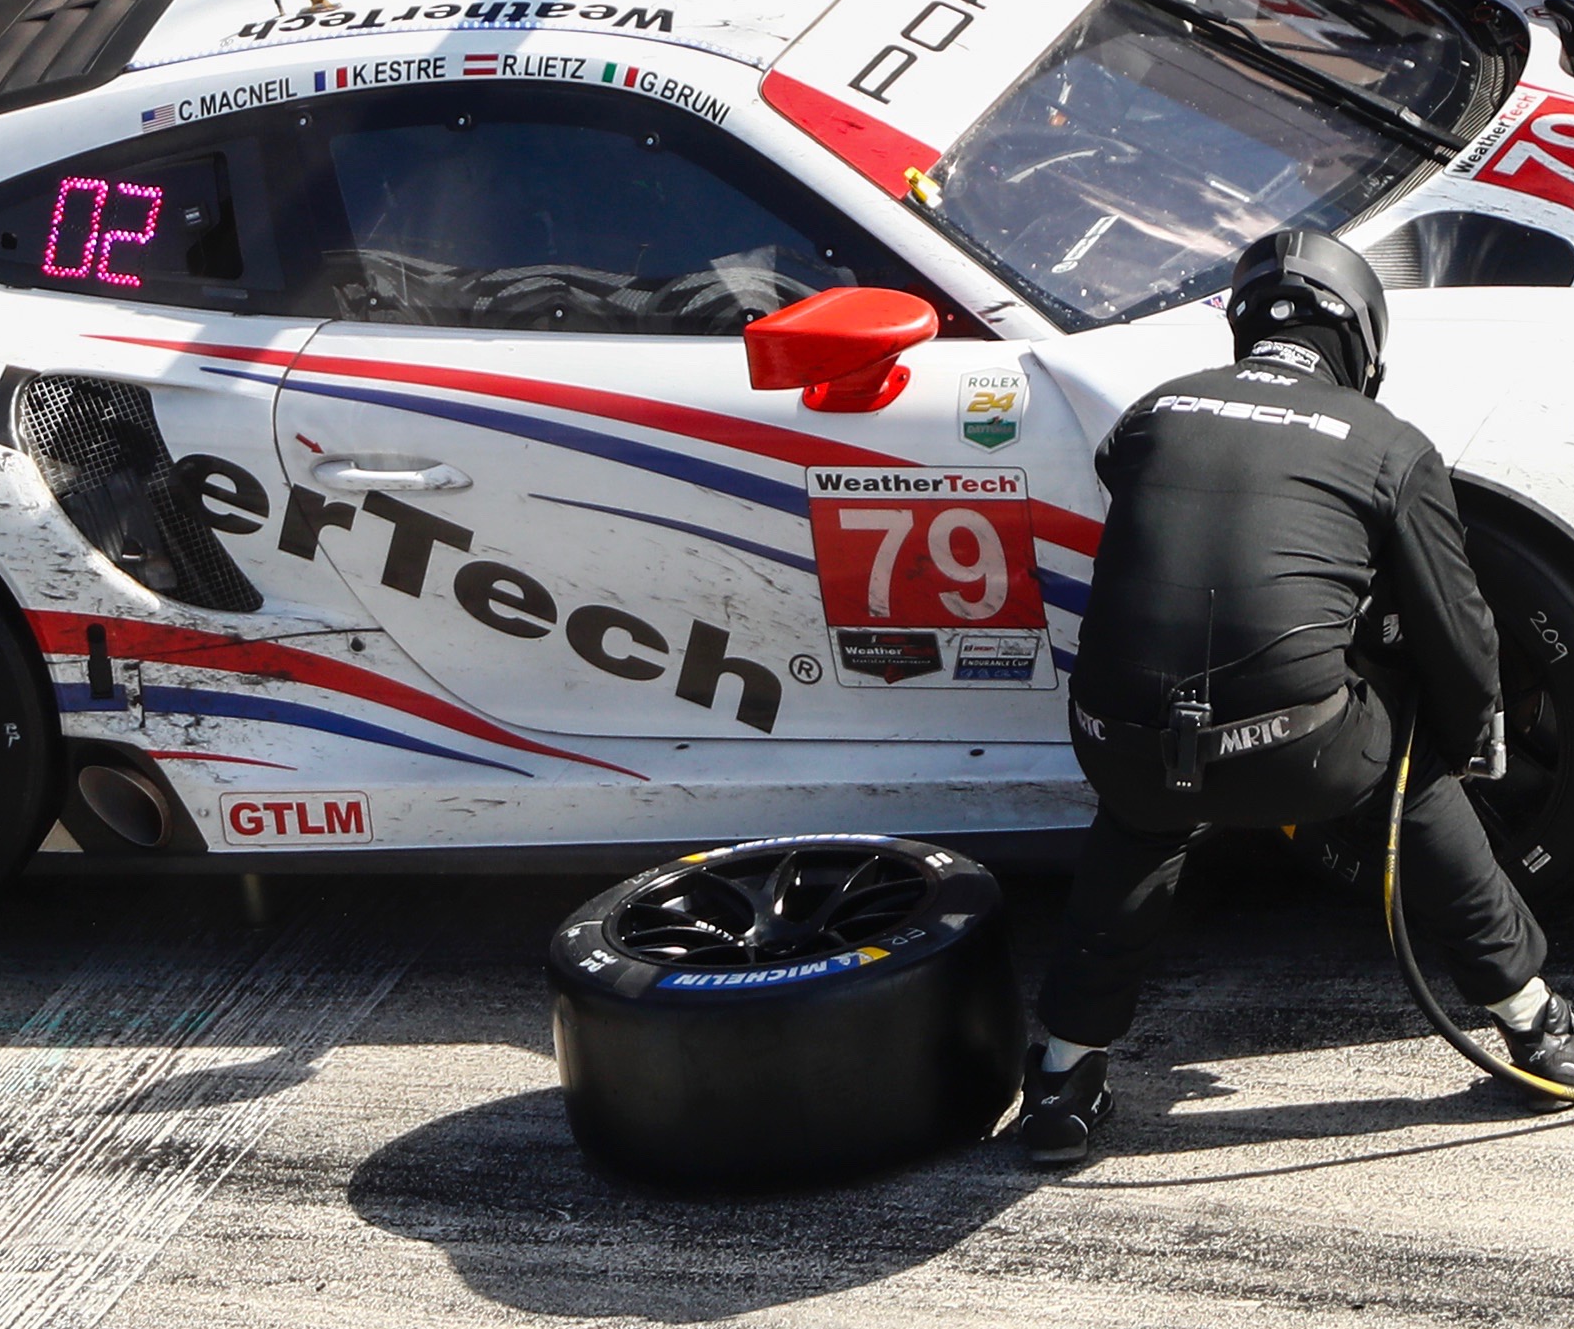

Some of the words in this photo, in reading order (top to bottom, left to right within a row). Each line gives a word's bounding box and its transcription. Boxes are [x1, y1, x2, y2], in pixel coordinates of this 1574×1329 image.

[1453, 93, 1537, 174] WeatherTech
[42, 175, 163, 288] 02
[968, 376, 1021, 388] ROLEX
[1236, 369, 1298, 386] HRX
[966, 391, 1018, 413] 24
[1152, 395, 1351, 440] PORSCHE
[815, 473, 1018, 494] WeatherTech
[838, 506, 1009, 621] 79
[1528, 610, 1569, 665] 209
[1074, 705, 1107, 742] RTC
[1220, 715, 1291, 756] MRTC
[228, 800, 365, 837] GTLM
[673, 960, 827, 987] MICHELIN
